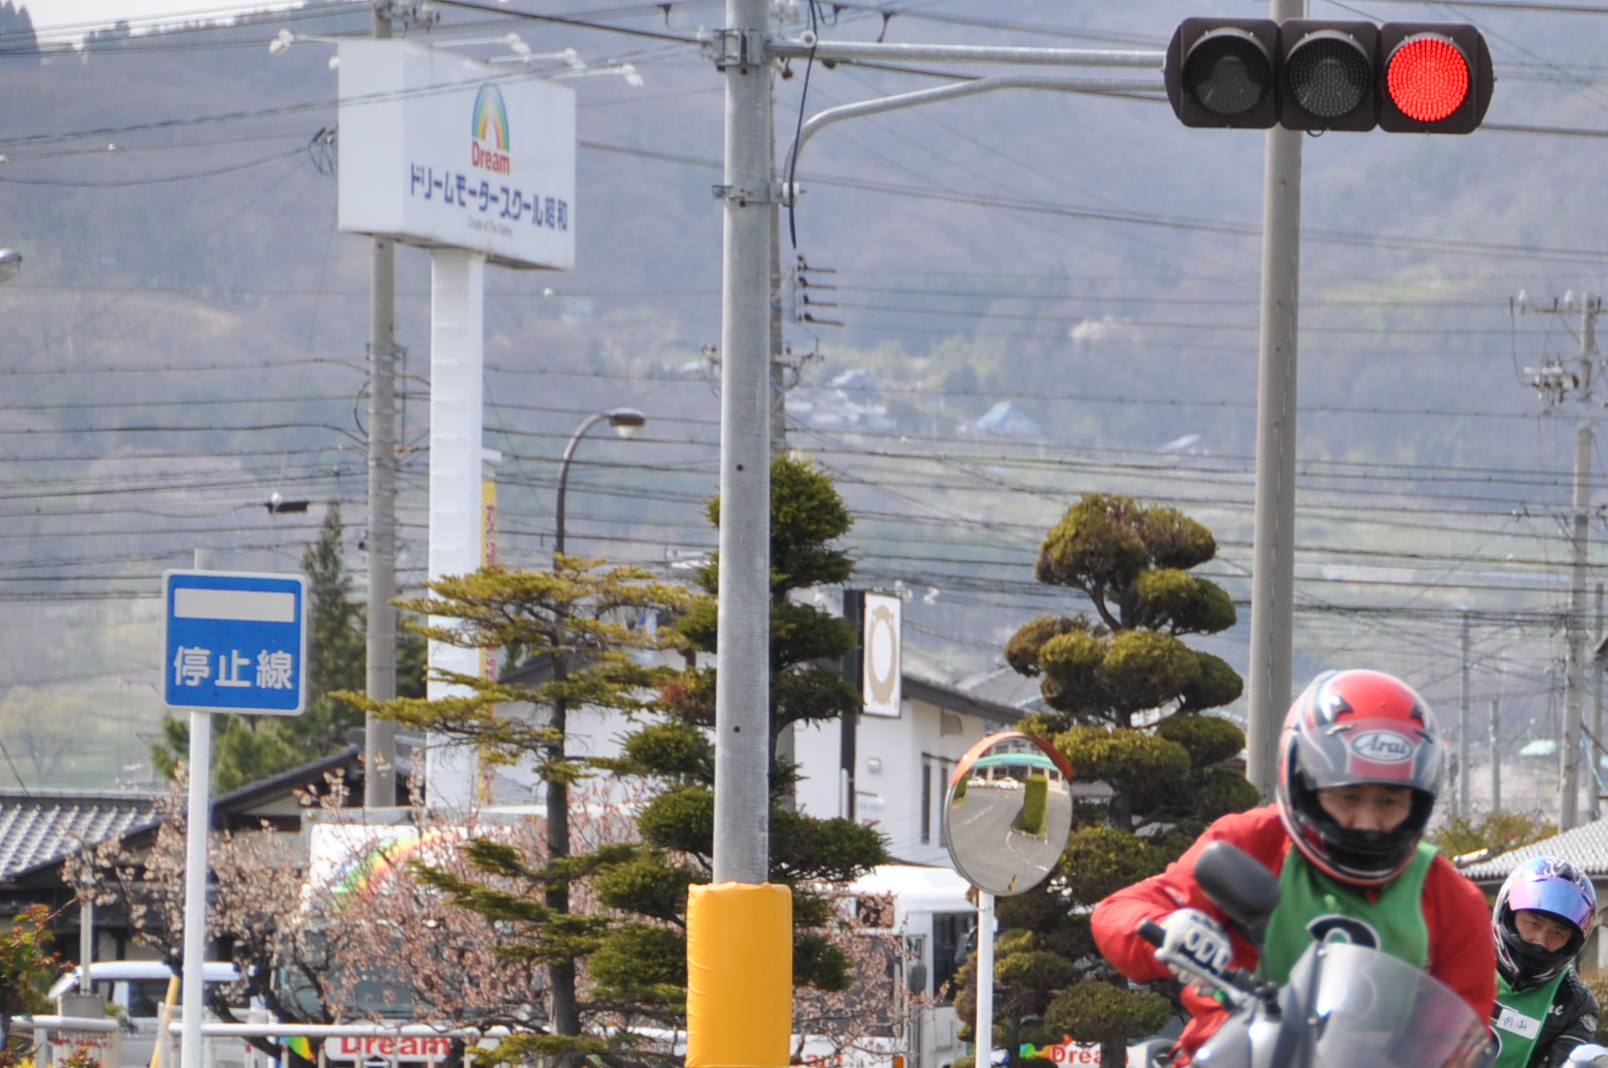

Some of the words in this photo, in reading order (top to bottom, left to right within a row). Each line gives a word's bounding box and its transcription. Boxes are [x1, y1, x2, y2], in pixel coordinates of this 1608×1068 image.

[471, 140, 510, 174] Dream
[410, 162, 568, 231] ドリームモータースクール昭和
[173, 645, 293, 690] 停止線
[1356, 733, 1406, 755] Arai
[340, 1035, 452, 1056] Dream
